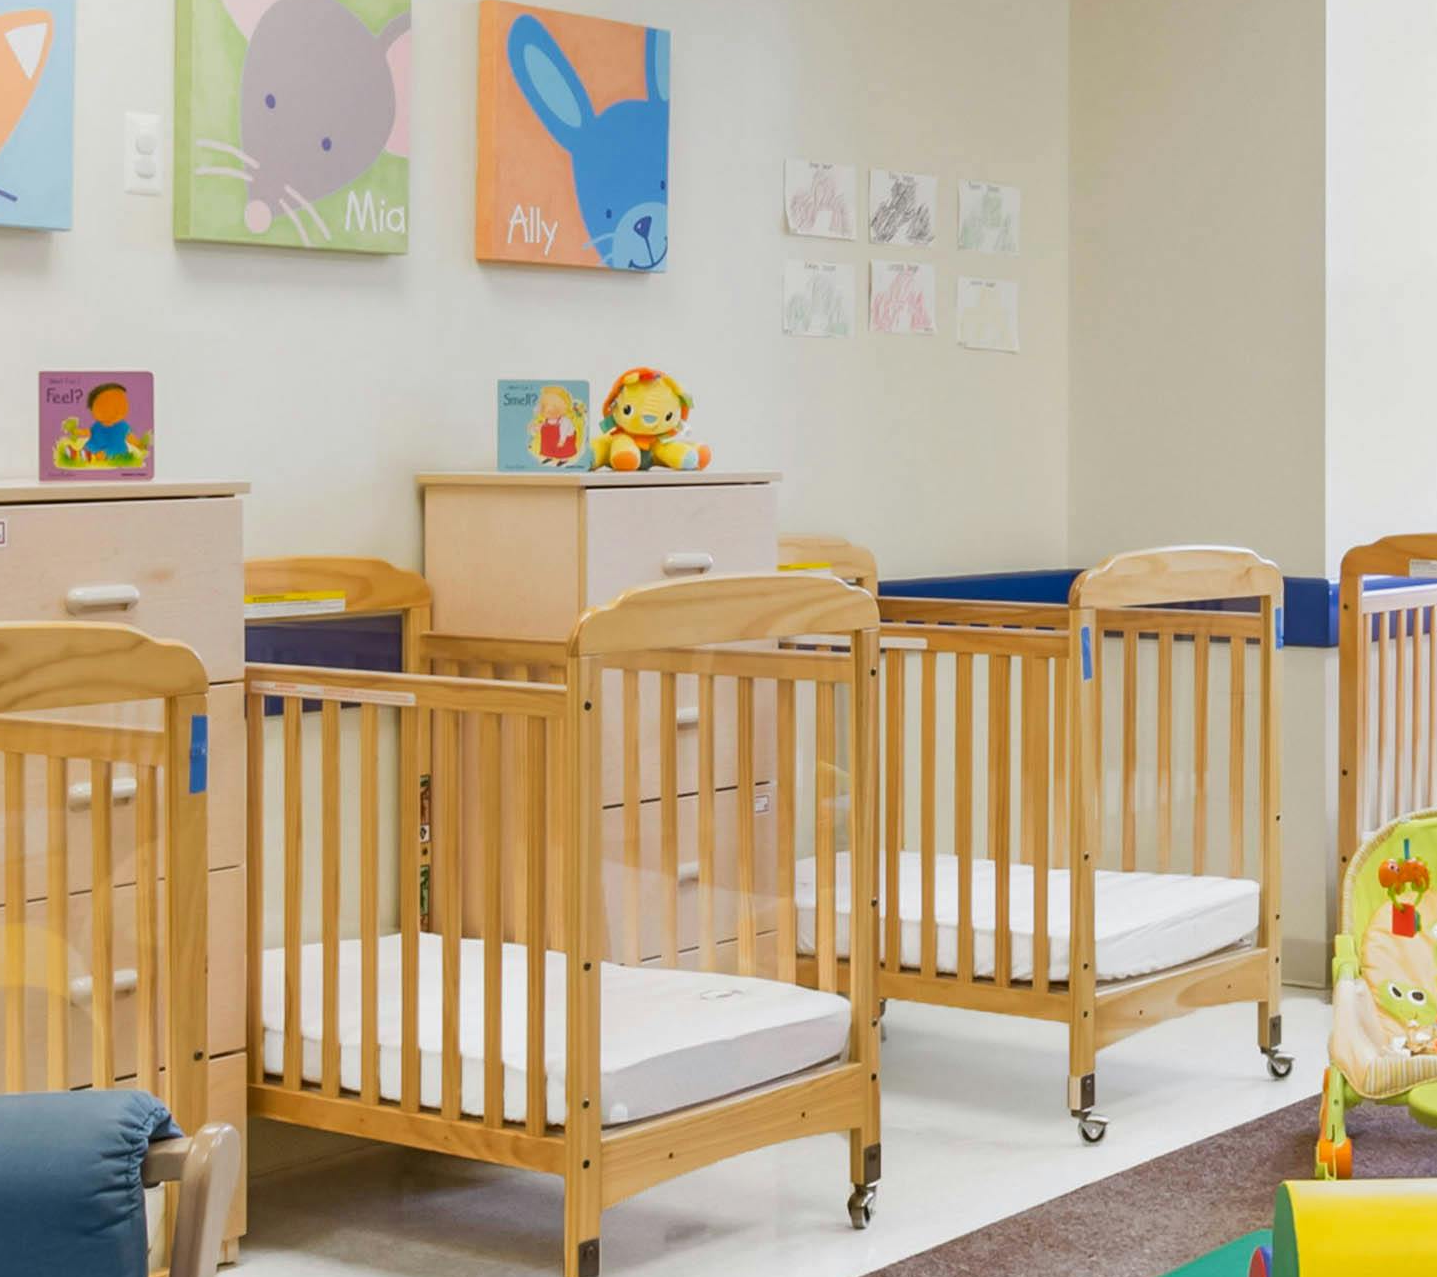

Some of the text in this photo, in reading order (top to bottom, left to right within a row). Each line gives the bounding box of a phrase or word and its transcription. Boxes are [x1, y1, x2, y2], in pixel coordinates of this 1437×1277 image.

[345, 190, 405, 234] Mia
[507, 203, 559, 257] Ally
[46, 387, 84, 404] Feel?
[503, 393, 538, 406] Smell?
